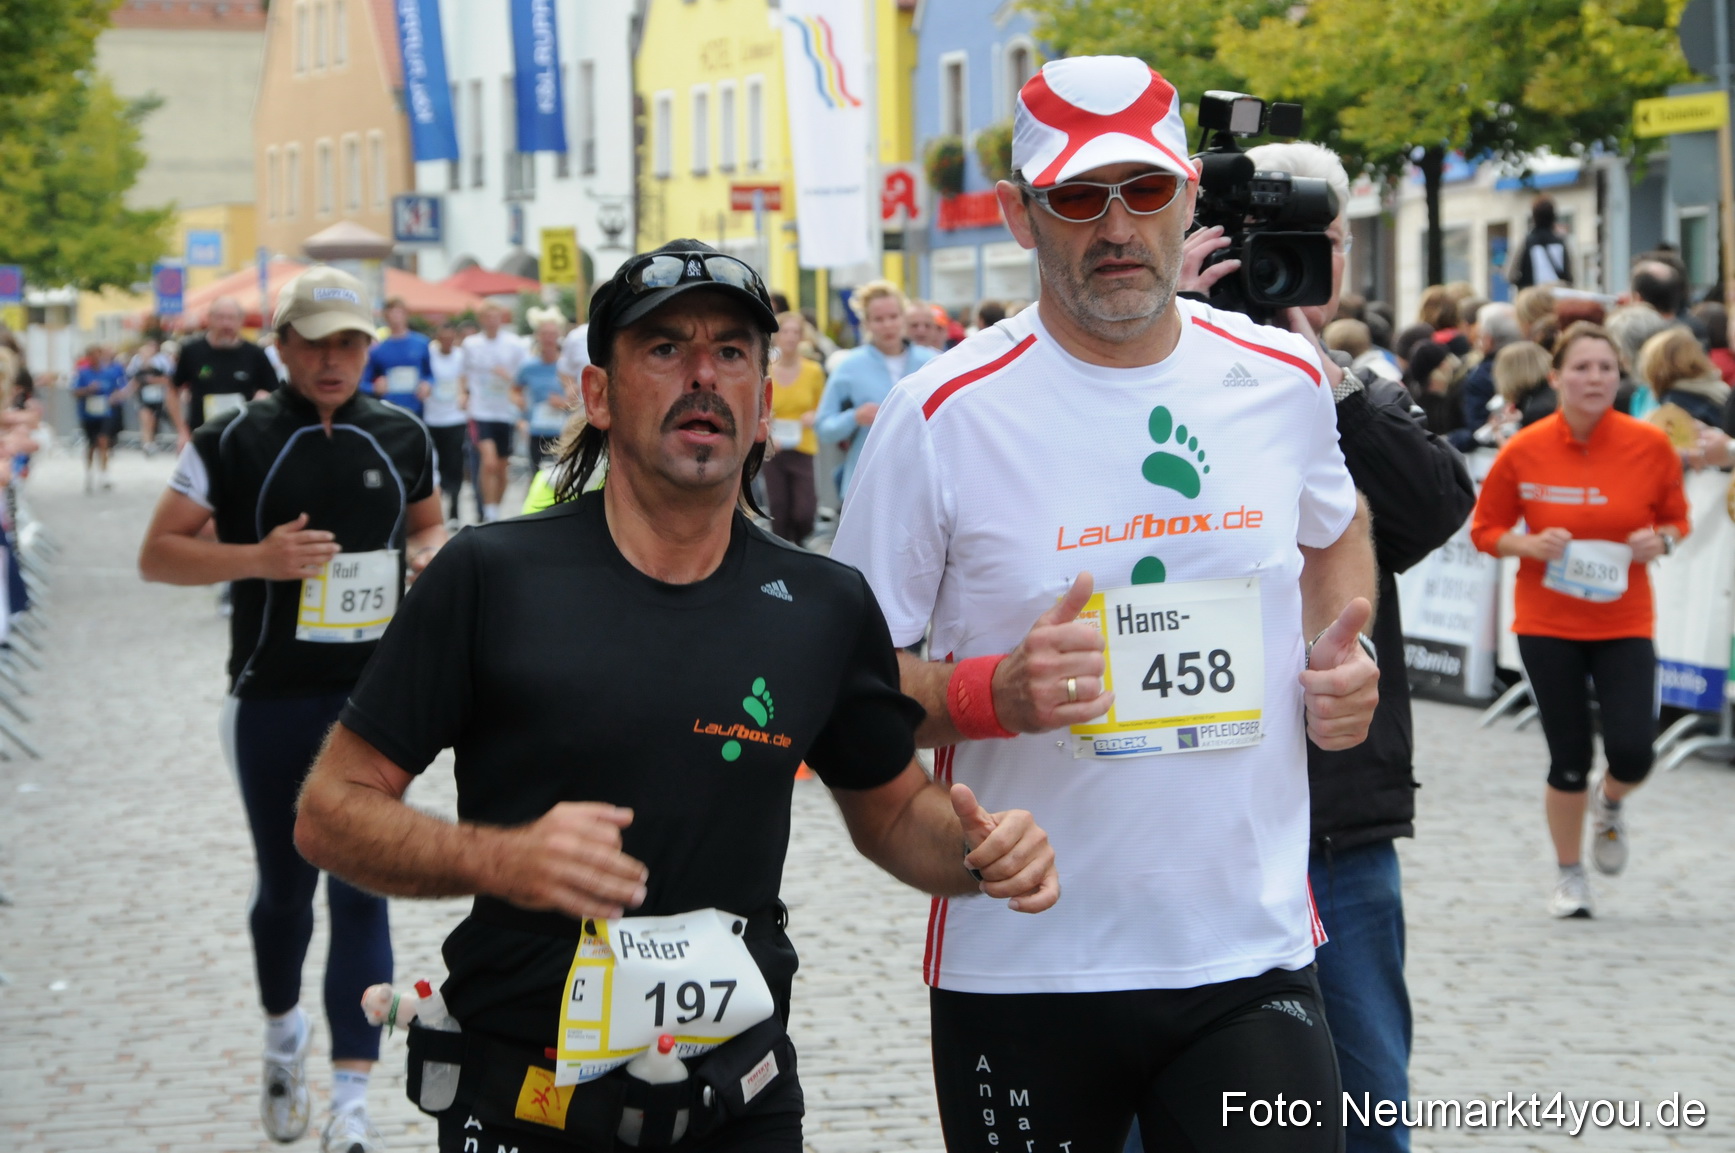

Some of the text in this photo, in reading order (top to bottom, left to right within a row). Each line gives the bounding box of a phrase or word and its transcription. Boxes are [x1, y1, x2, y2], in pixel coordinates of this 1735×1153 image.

[550, 243, 571, 271] B
[1222, 377, 1260, 388] adidas
[1056, 505, 1263, 551] Laufbox.de
[332, 562, 359, 578] Ralf
[1573, 559, 1619, 582] 3530
[341, 587, 384, 612] 875
[761, 583, 794, 602] adidas
[1116, 604, 1190, 635] Hans-
[1142, 649, 1235, 698] 458
[693, 718, 792, 748] Laufbox.de
[1201, 721, 1260, 739] PFLEIDERER
[619, 930, 690, 960] Peter
[572, 978, 585, 1001] C
[645, 979, 737, 1027] 197
